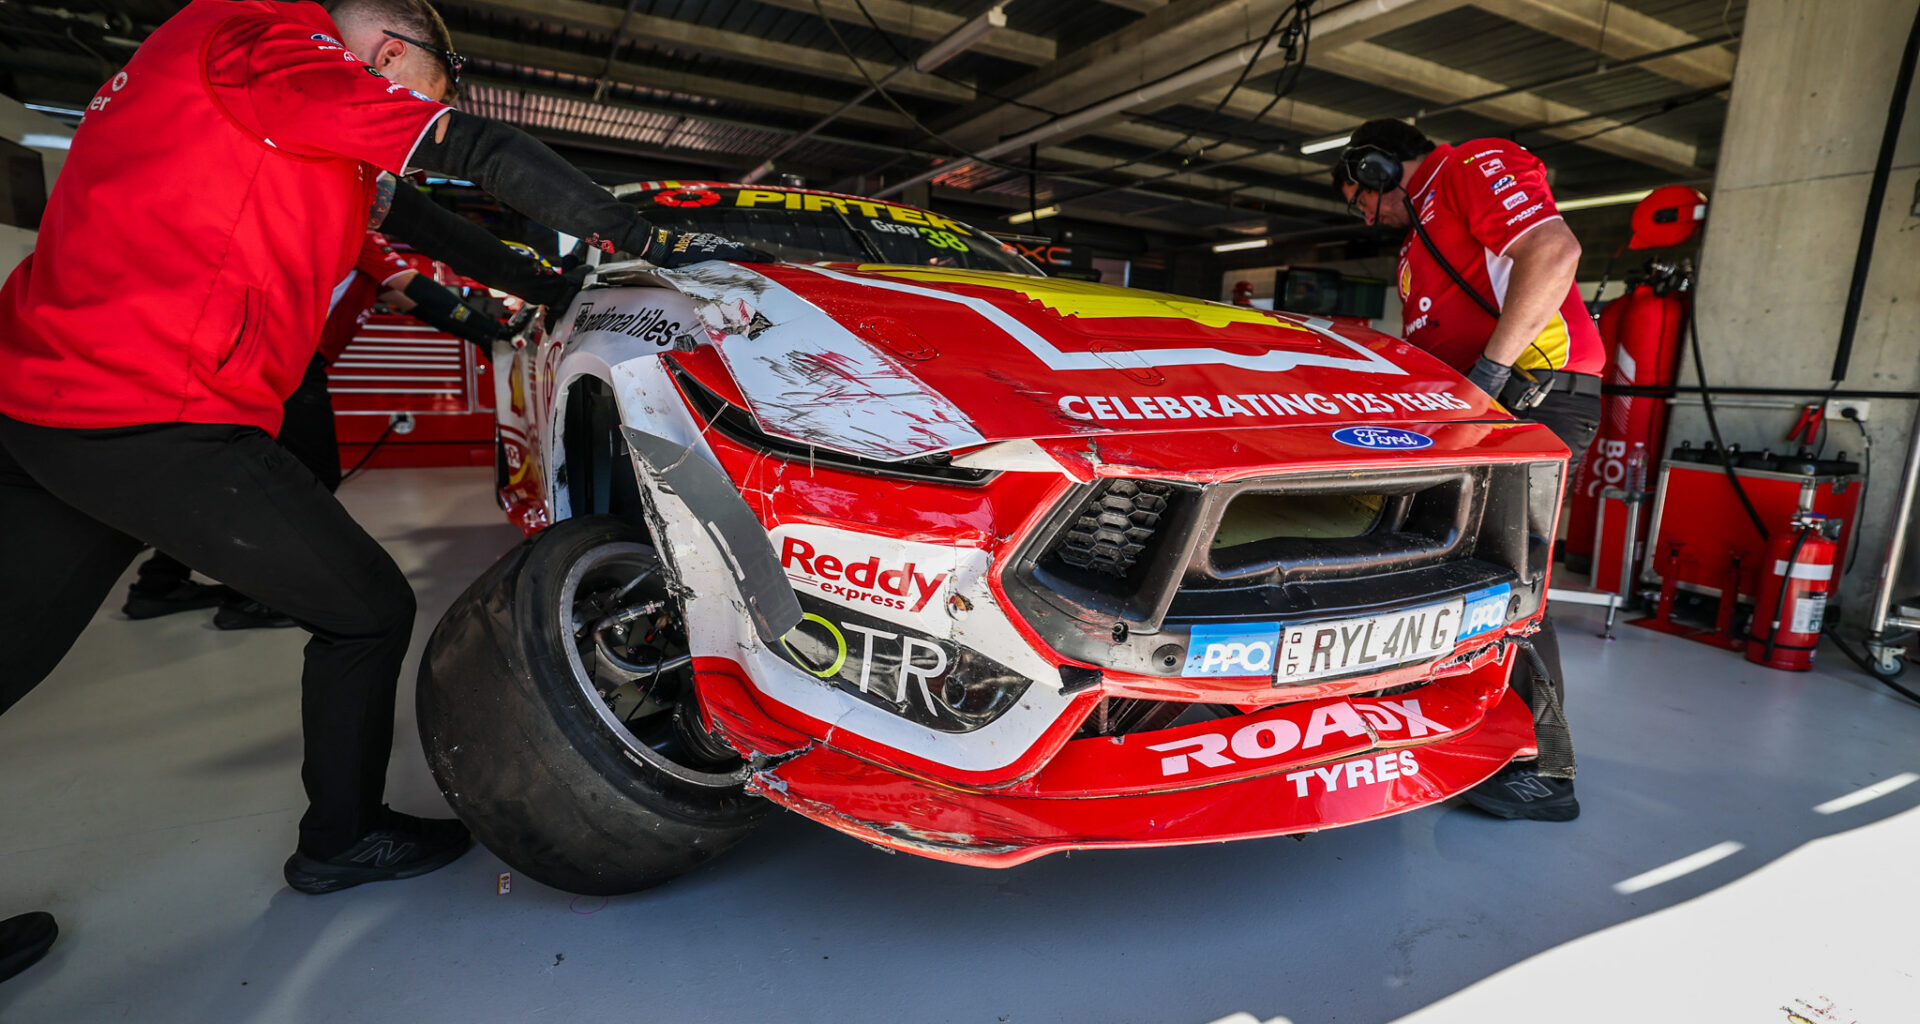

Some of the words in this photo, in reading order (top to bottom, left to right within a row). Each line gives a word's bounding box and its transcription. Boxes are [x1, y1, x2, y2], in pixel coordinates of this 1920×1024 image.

[736, 189, 972, 236] PIRTEK
[870, 218, 920, 239] Gray
[918, 227, 969, 253] 38
[583, 306, 647, 333] national
[626, 308, 680, 347] tiles
[1058, 393, 1341, 420] CELEBRATING
[1333, 393, 1395, 414] 125
[1381, 392, 1472, 412] YEARS
[1353, 428, 1418, 446] Ford
[780, 536, 948, 613] Reddy
[820, 582, 906, 610] express
[1286, 632, 1303, 676] QLD
[1308, 612, 1426, 673] RYL4N
[1430, 608, 1452, 650] G
[779, 611, 948, 718] OTR
[1146, 699, 1452, 776] ROADX
[1285, 750, 1419, 798] TYRES
